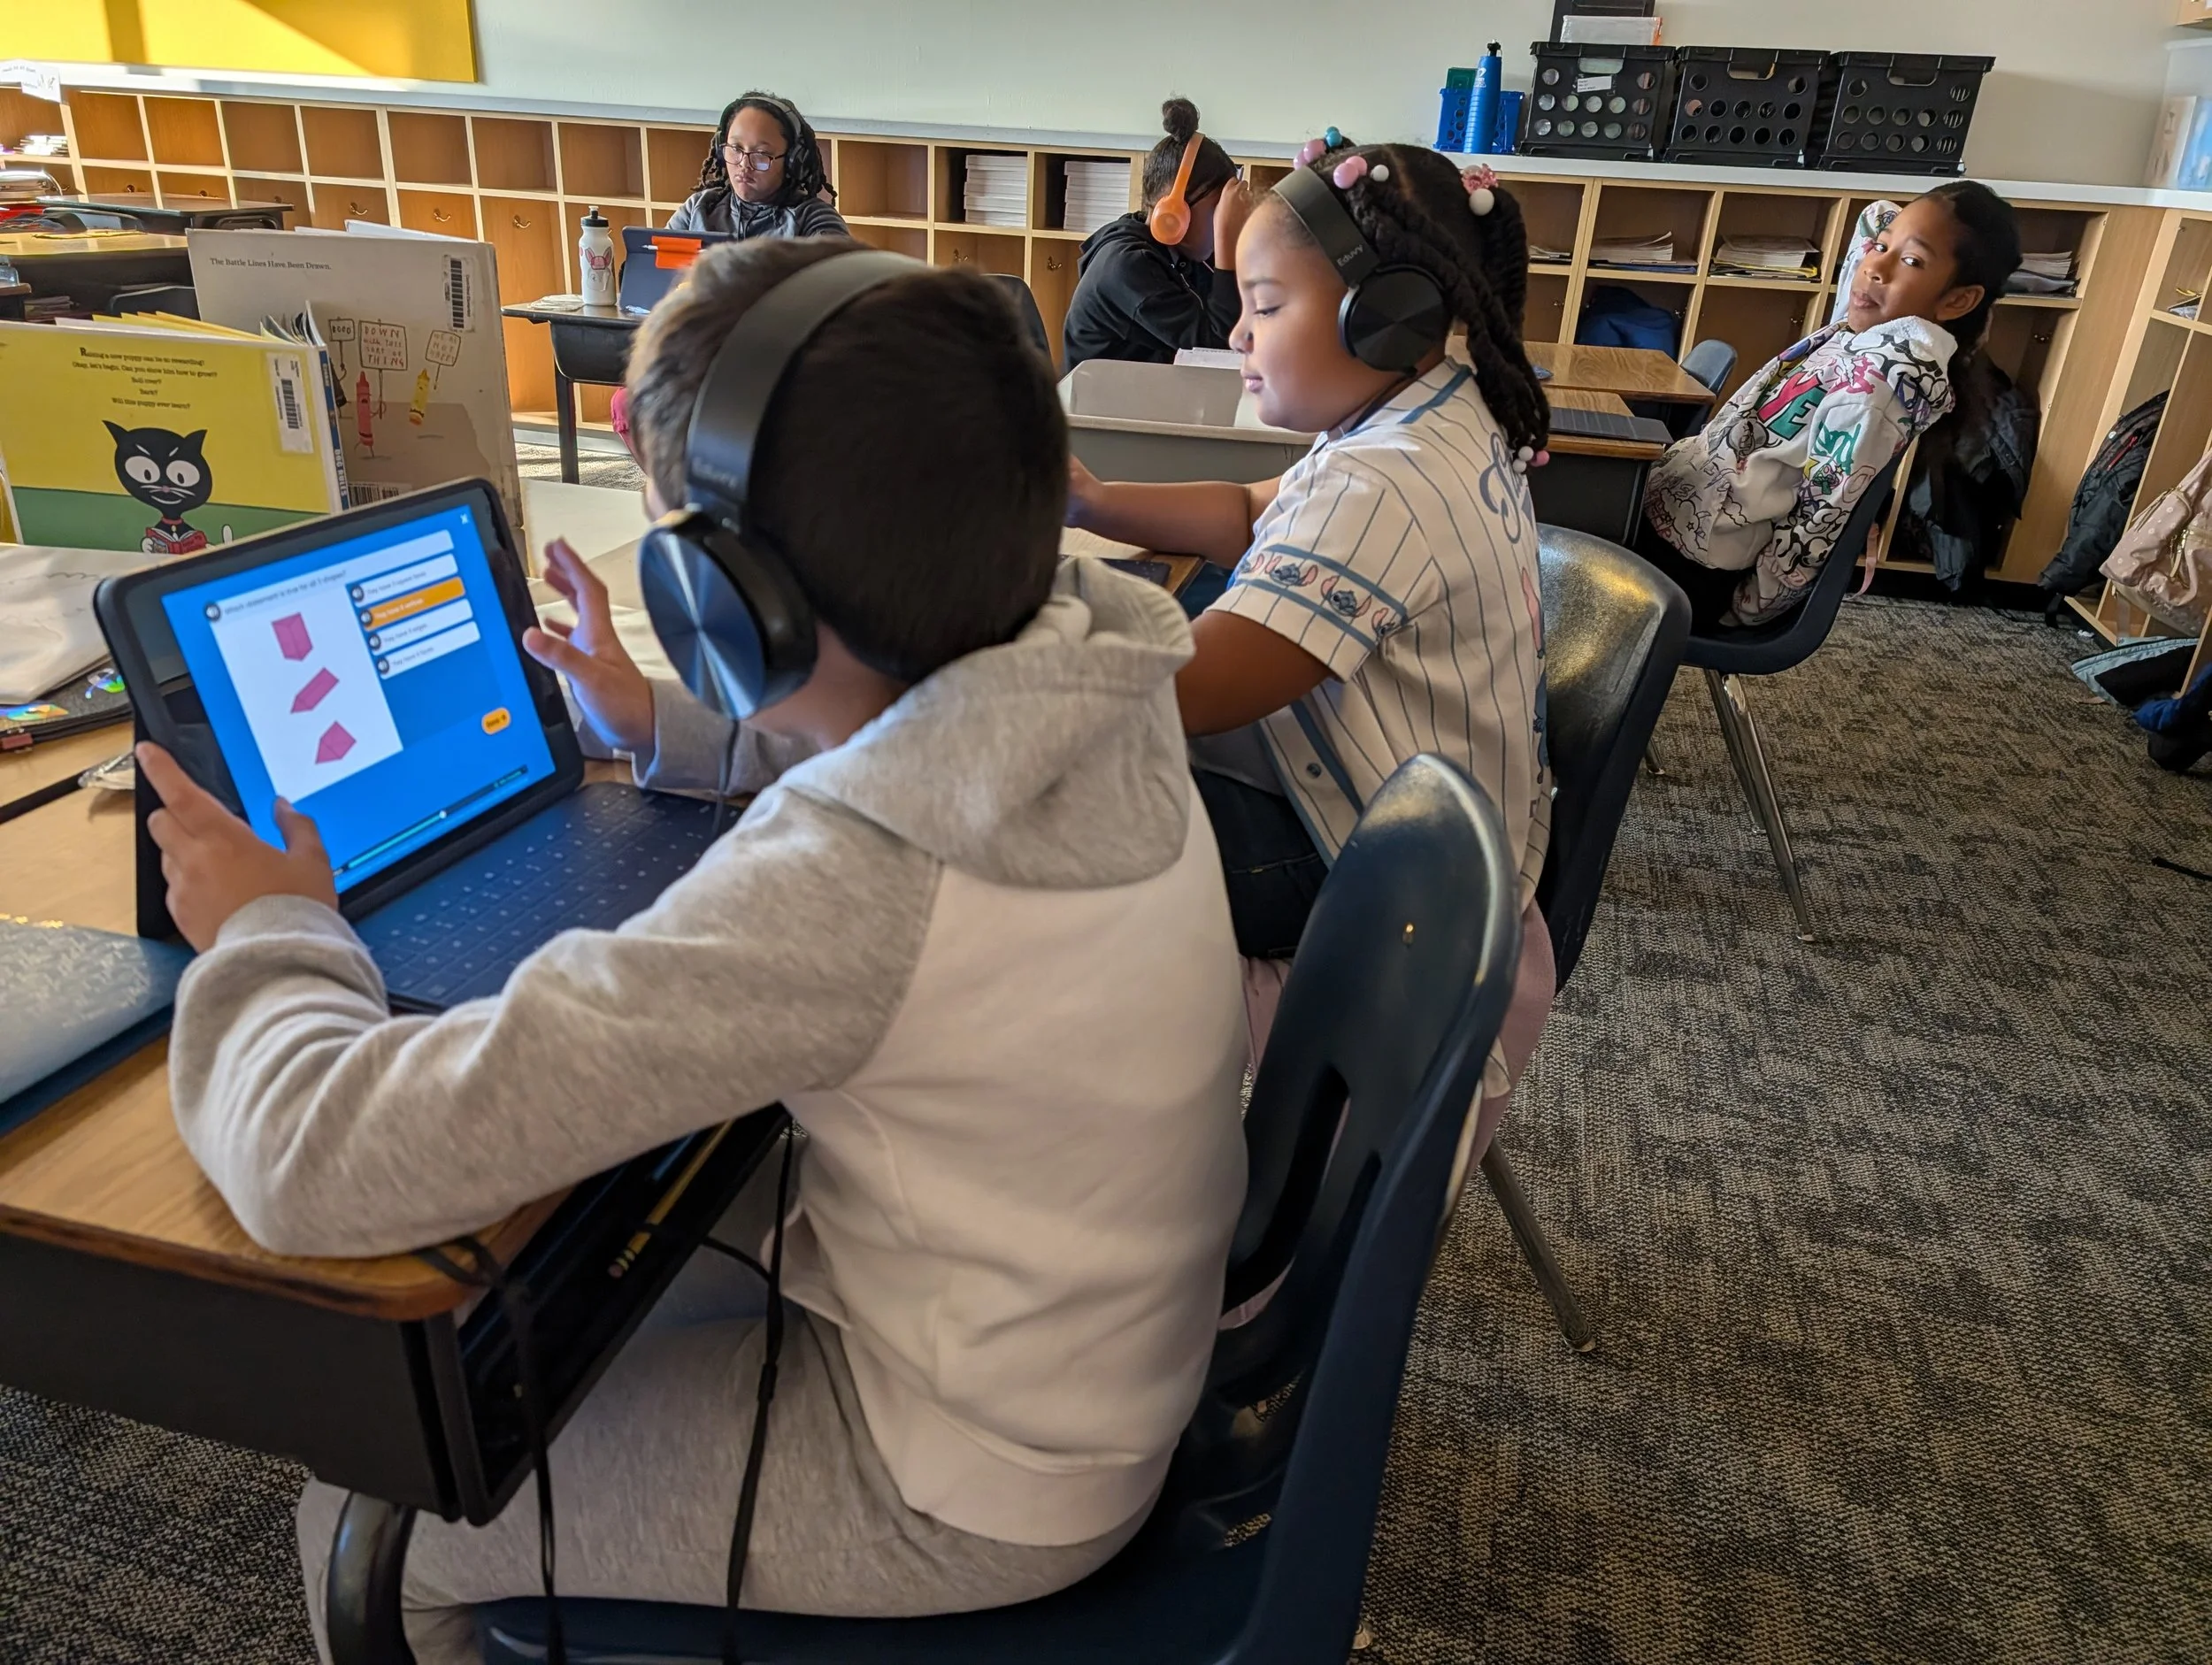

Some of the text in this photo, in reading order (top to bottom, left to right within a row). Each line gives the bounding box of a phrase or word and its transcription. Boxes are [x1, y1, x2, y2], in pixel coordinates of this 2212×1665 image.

[1337, 244, 1363, 266] Eduvy
[365, 325, 399, 338] DOWN
[368, 354, 403, 367] THING
[334, 449, 348, 496] DOG RULES
